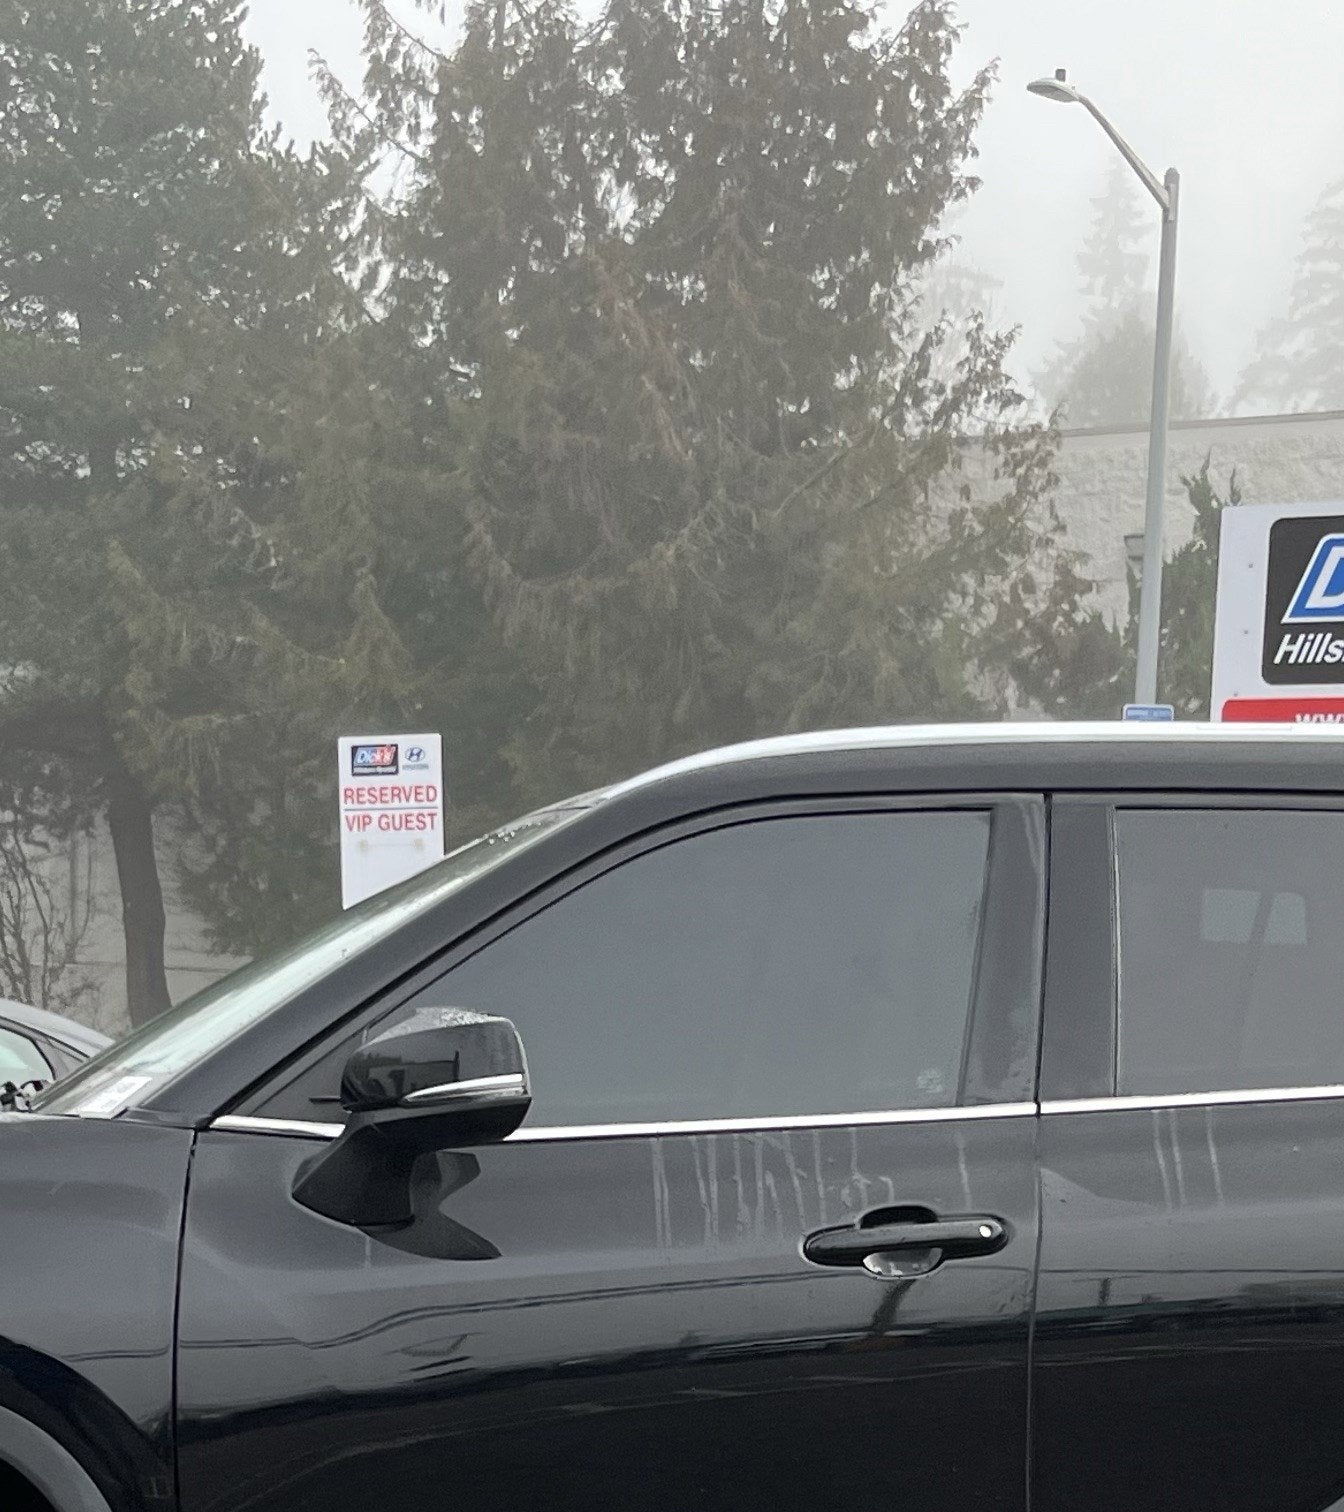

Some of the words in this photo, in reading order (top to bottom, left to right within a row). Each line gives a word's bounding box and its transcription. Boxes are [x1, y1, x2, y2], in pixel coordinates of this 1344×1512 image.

[343, 785, 438, 805] RESERVED
[345, 814, 373, 832] VIP
[377, 812, 438, 831] GUEST
